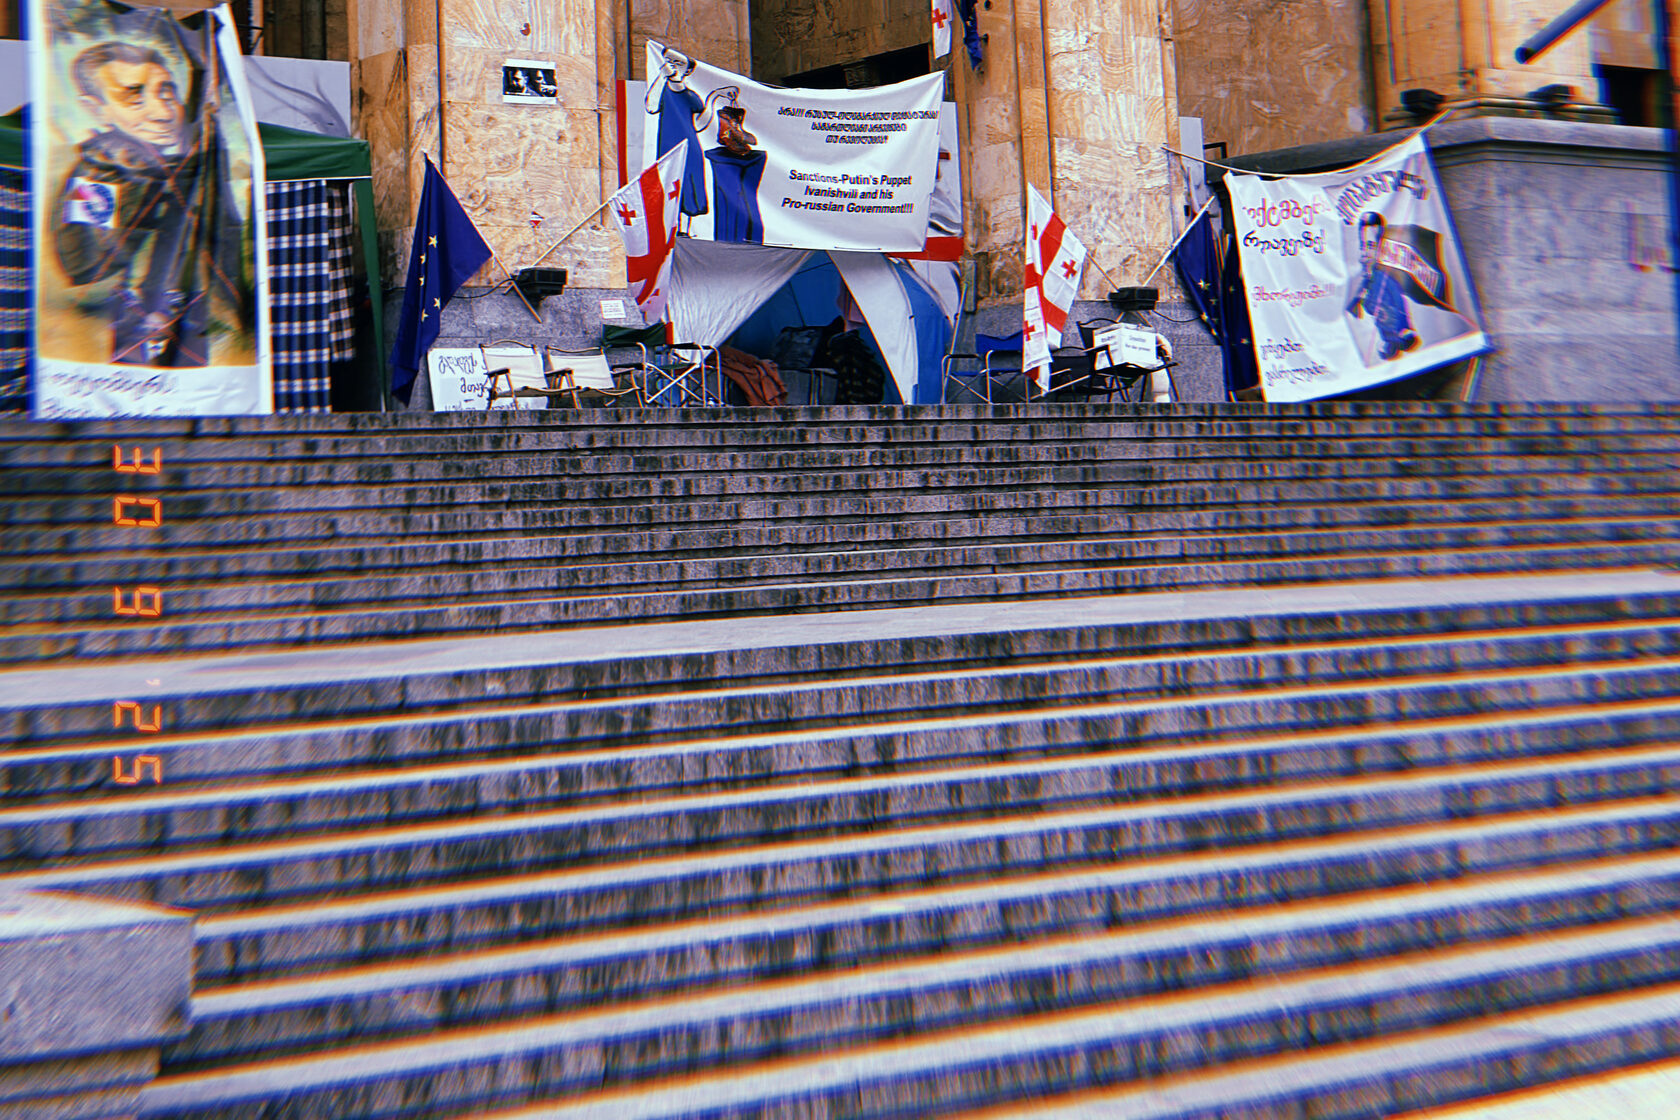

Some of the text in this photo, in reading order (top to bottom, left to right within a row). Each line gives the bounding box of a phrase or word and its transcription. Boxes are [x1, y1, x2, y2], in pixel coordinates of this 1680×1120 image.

[789, 169, 912, 187] Sanctions-Putin's Puppet
[804, 186, 894, 199] Ivanishvili and his
[781, 198, 914, 213] Pro-russian Government!!!
